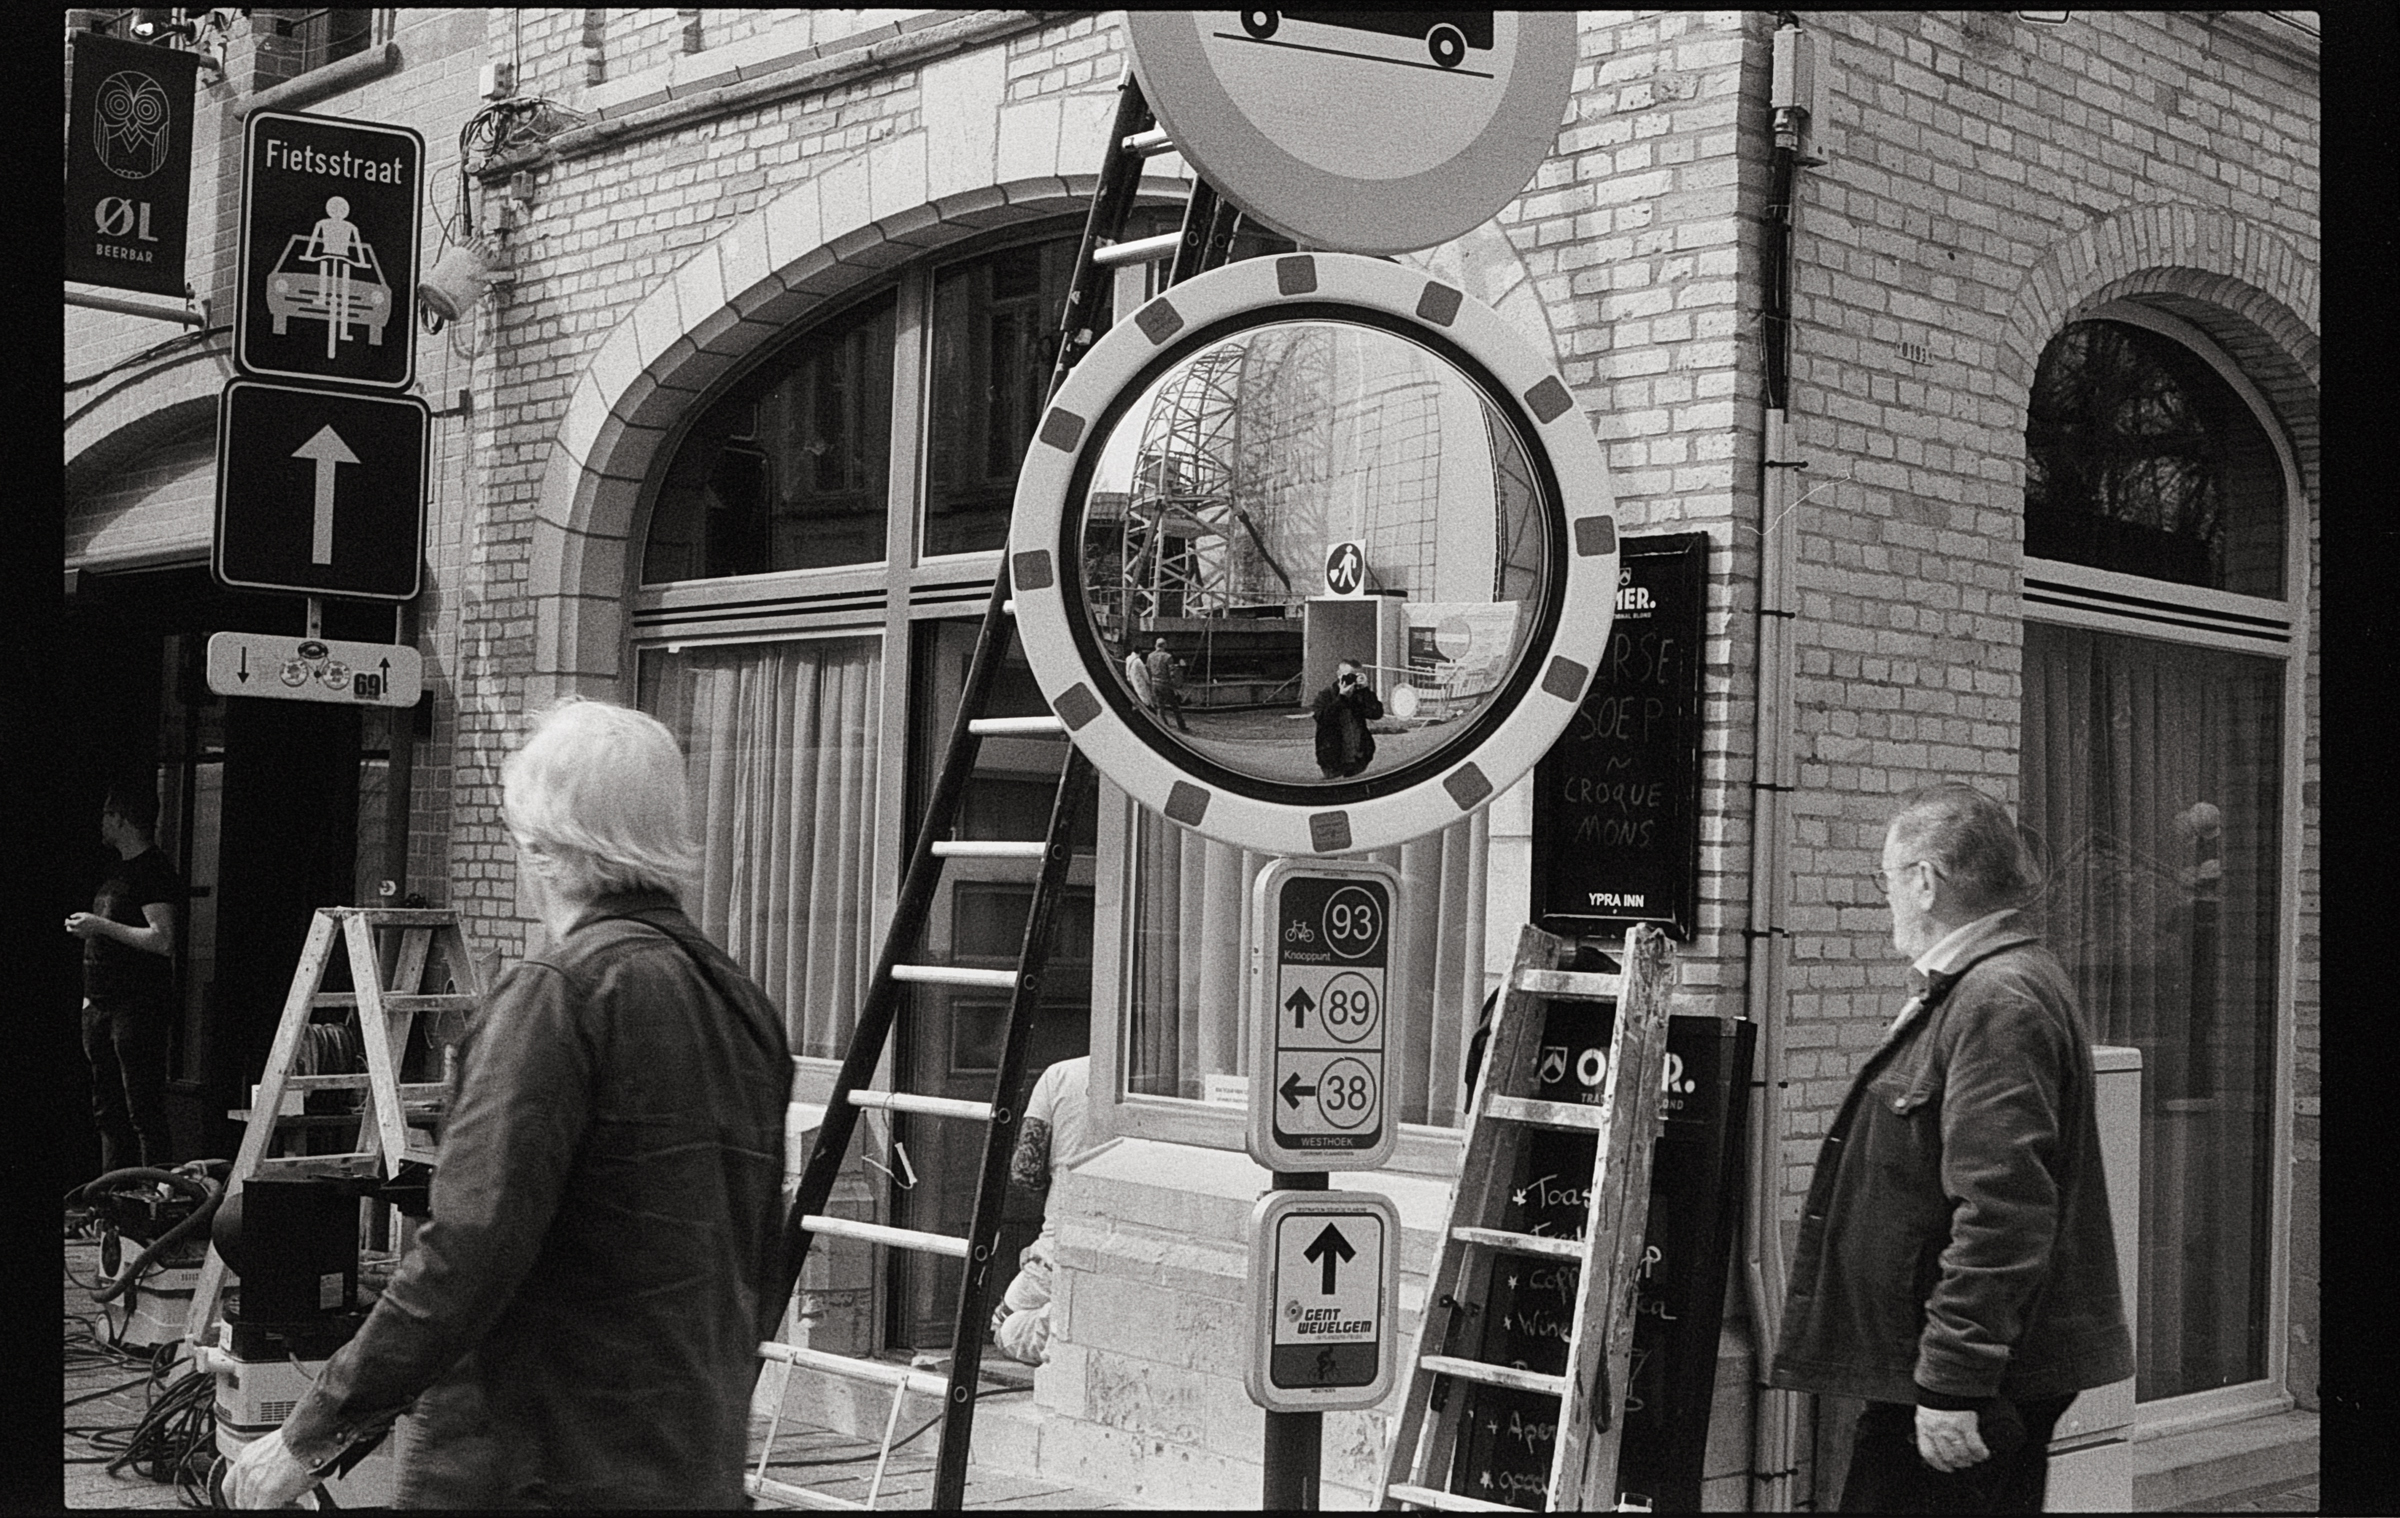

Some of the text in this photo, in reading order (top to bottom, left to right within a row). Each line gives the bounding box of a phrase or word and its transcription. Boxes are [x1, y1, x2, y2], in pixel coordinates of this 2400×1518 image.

[266, 139, 403, 185] Fietsstraat
[95, 196, 158, 242] ØL
[96, 243, 153, 263] BEERBAR
[1598, 632, 1674, 685] RSE
[353, 673, 380, 696] 69
[1580, 694, 1663, 744] SOEP
[1574, 814, 1654, 848] MONS
[1588, 892, 1644, 908] YPRA INN
[1332, 904, 1372, 940] 93
[1284, 950, 1331, 962] Knooppunt
[1329, 989, 1369, 1026] 89
[1326, 1075, 1367, 1111] 38
[1301, 1137, 1353, 1146] WESTHOEK
[1297, 1321, 1372, 1334] WEVELGEM
[1305, 1308, 1341, 1321] GENT
